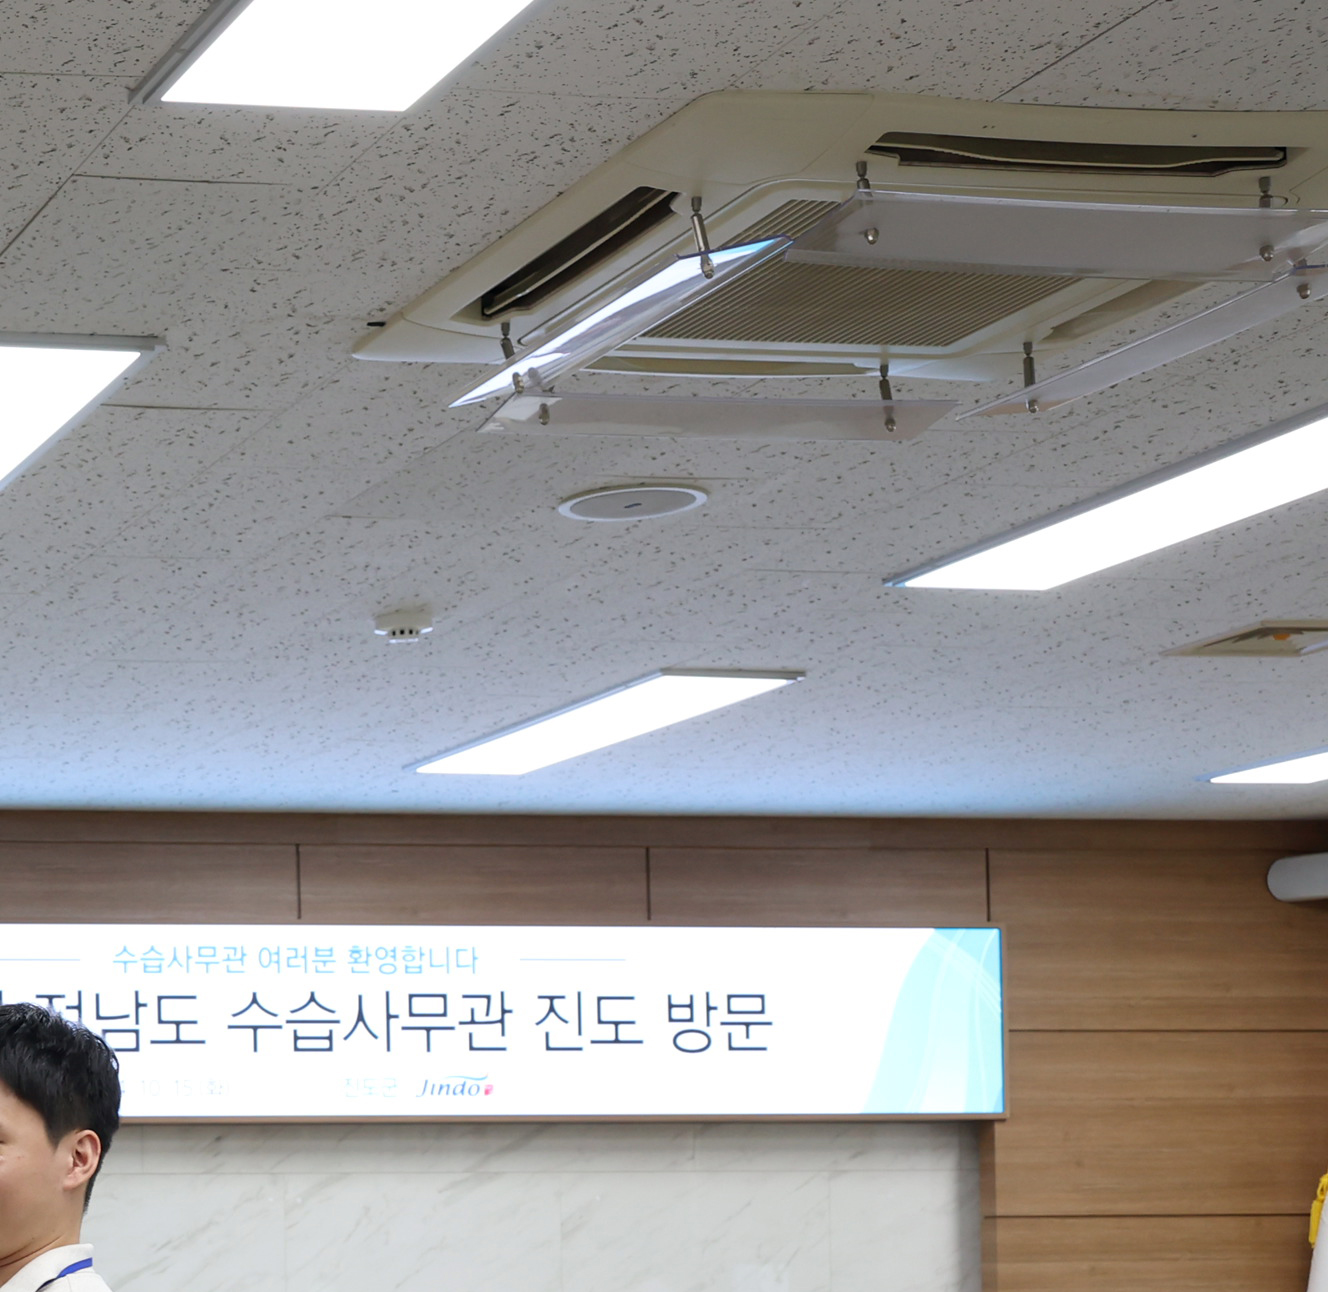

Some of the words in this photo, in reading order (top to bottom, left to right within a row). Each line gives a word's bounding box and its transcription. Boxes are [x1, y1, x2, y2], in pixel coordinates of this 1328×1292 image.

[113, 946, 247, 974] 수습사무관
[259, 946, 336, 974] 여러분
[348, 946, 478, 974] 환영합니다
[228, 991, 513, 1053] 수습사무관
[535, 991, 643, 1052] 진도
[668, 992, 773, 1054] 방문
[345, 1078, 397, 1098] 진도군
[416, 1077, 481, 1098] Jindo
